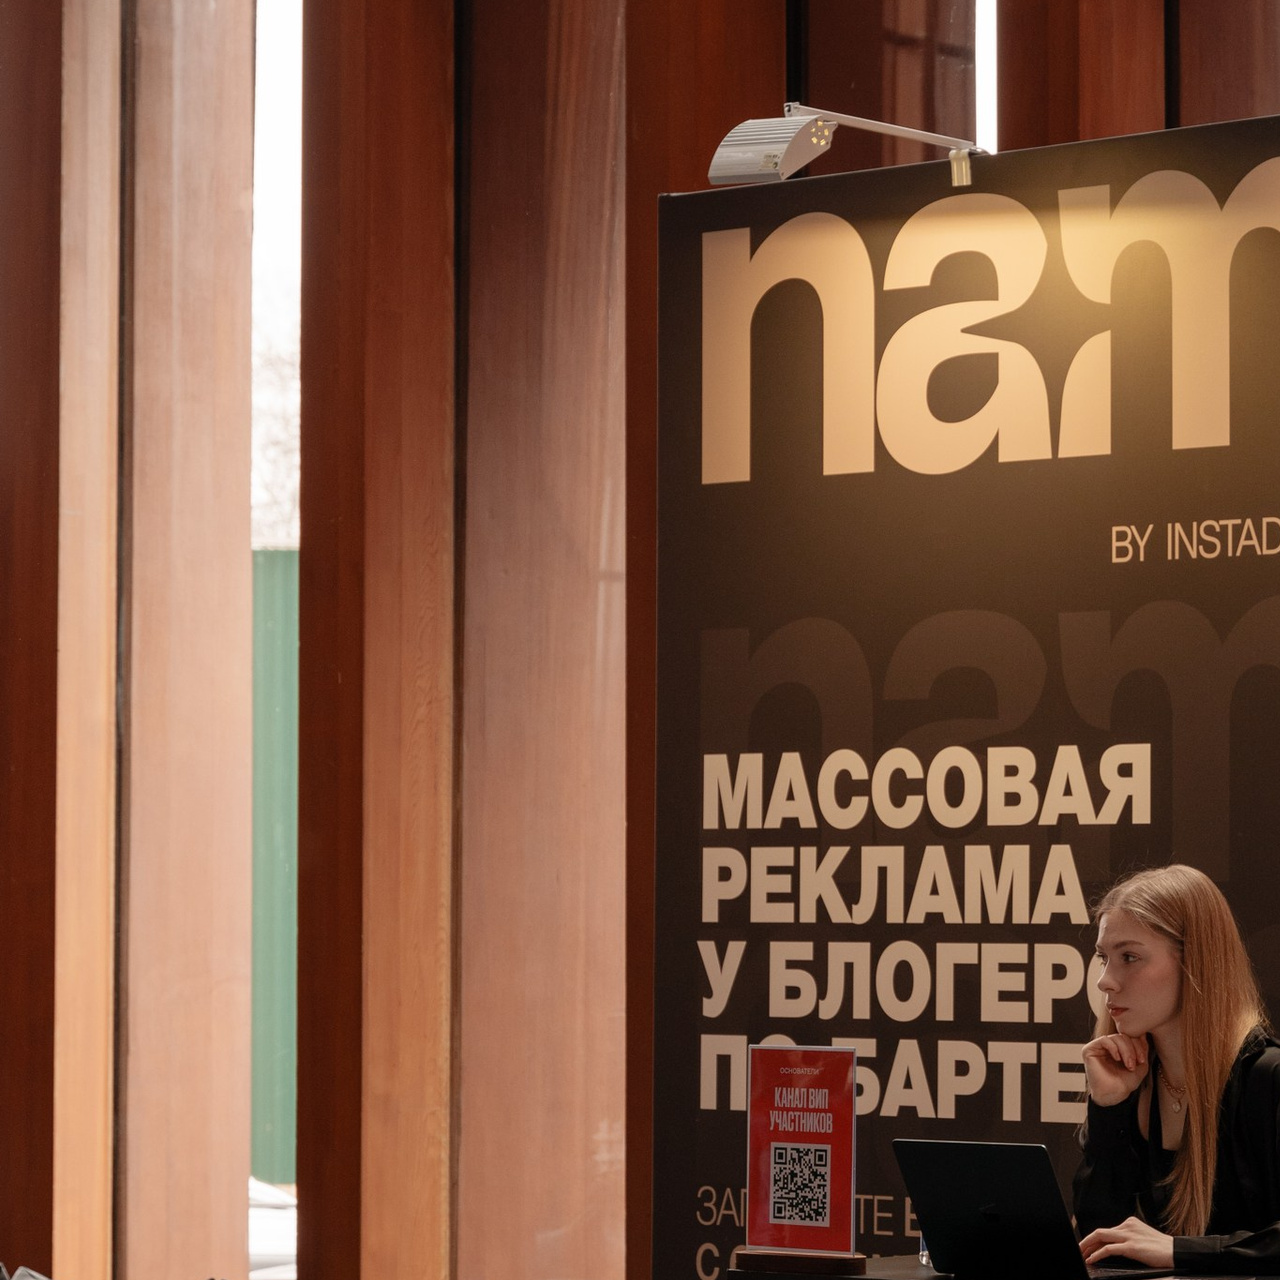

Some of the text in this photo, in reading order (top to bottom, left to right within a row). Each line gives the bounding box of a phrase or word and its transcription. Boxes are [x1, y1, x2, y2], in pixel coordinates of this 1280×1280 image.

[1111, 524, 1154, 564] BY
[702, 743, 1151, 830] МАССОВАЯ
[702, 844, 1091, 925] РЕКЛАМА
[697, 940, 747, 1019] У
[769, 940, 1107, 1024] БЛОГЕР
[774, 1087, 829, 1109] КАНАЛ ВИП
[779, 1067, 820, 1075] ОСНОВАТЕЛИ
[831, 1037, 1088, 1124] БАРТЕ
[769, 1110, 833, 1134] УЧАСТНИКОВ
